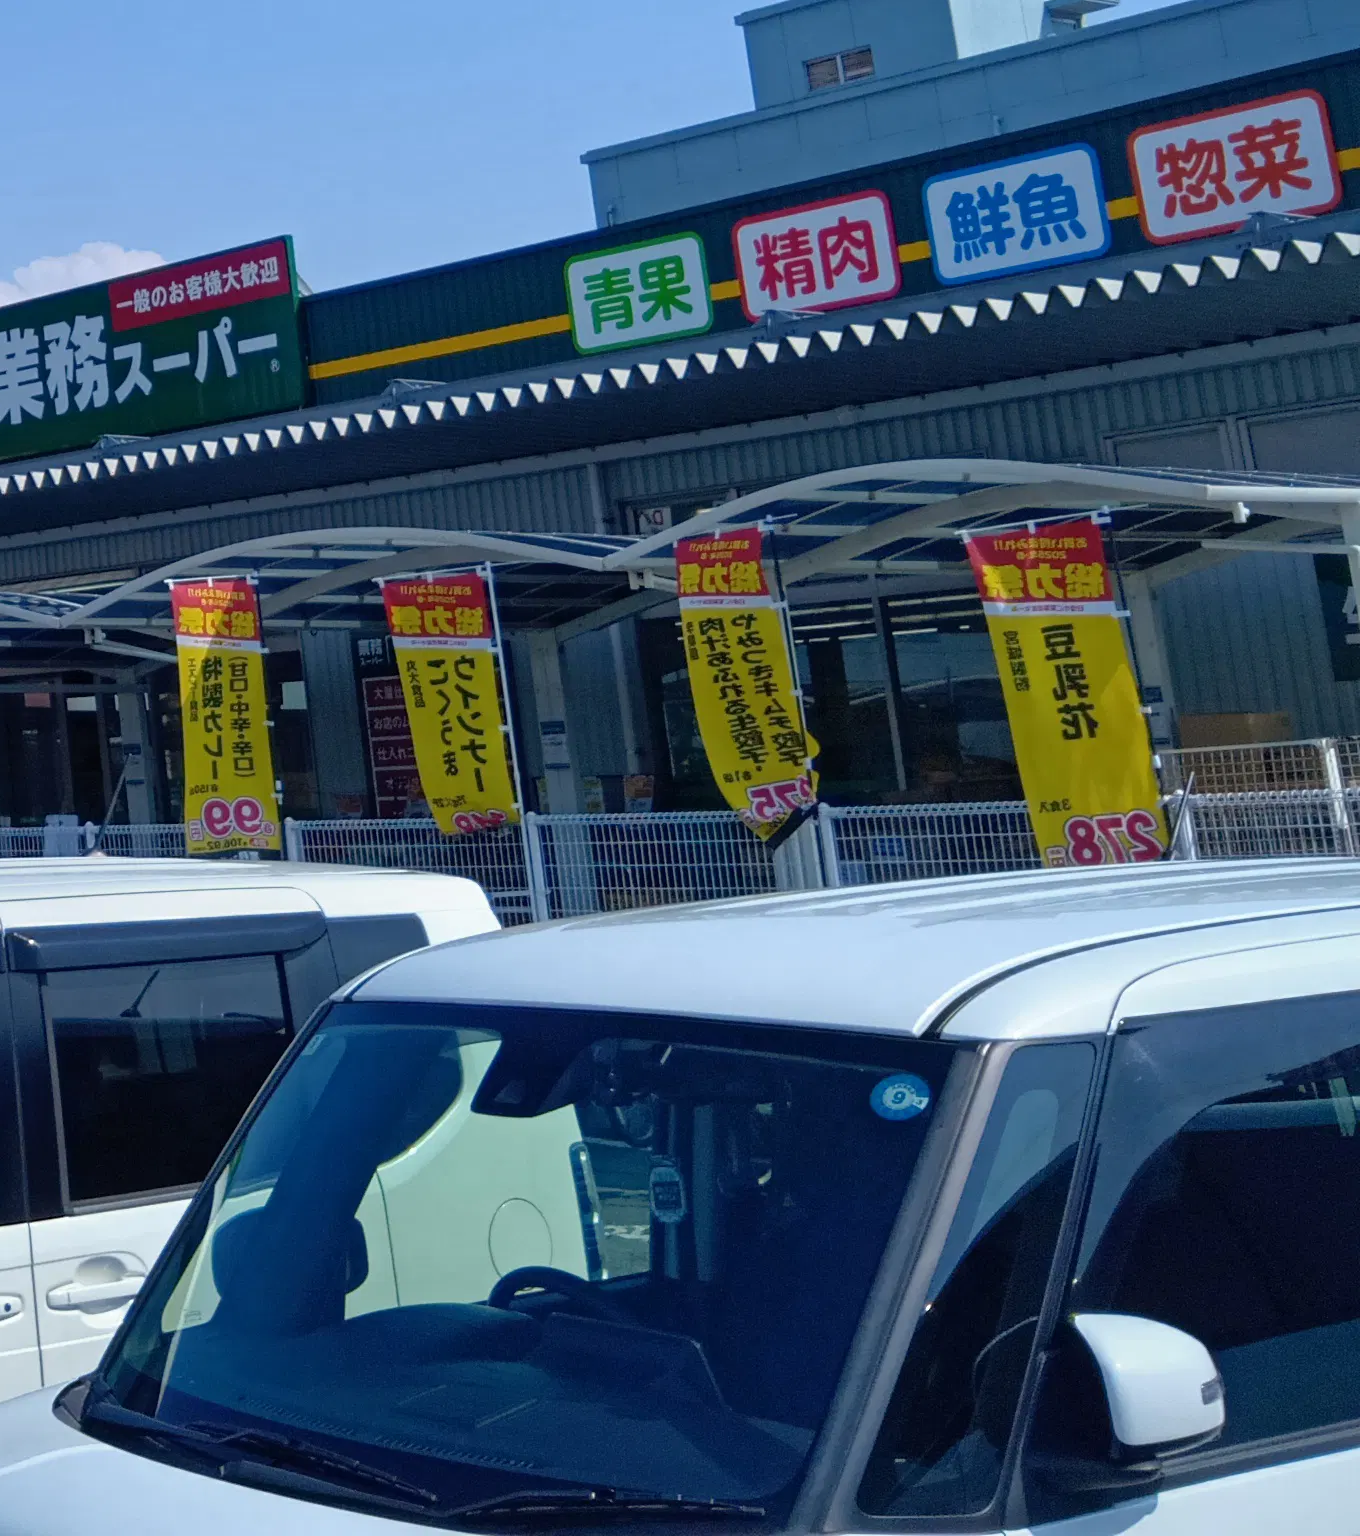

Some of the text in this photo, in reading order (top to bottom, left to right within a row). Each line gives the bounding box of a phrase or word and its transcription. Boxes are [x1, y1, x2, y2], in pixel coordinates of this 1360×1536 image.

[1155, 117, 1313, 219] 惣菜
[753, 216, 880, 302] 精肉
[945, 173, 1087, 263] 鮮魚
[116, 256, 279, 315] 一般のお客様大歓迎
[583, 253, 693, 334] 青果
[891, 1090, 906, 1105] 9
